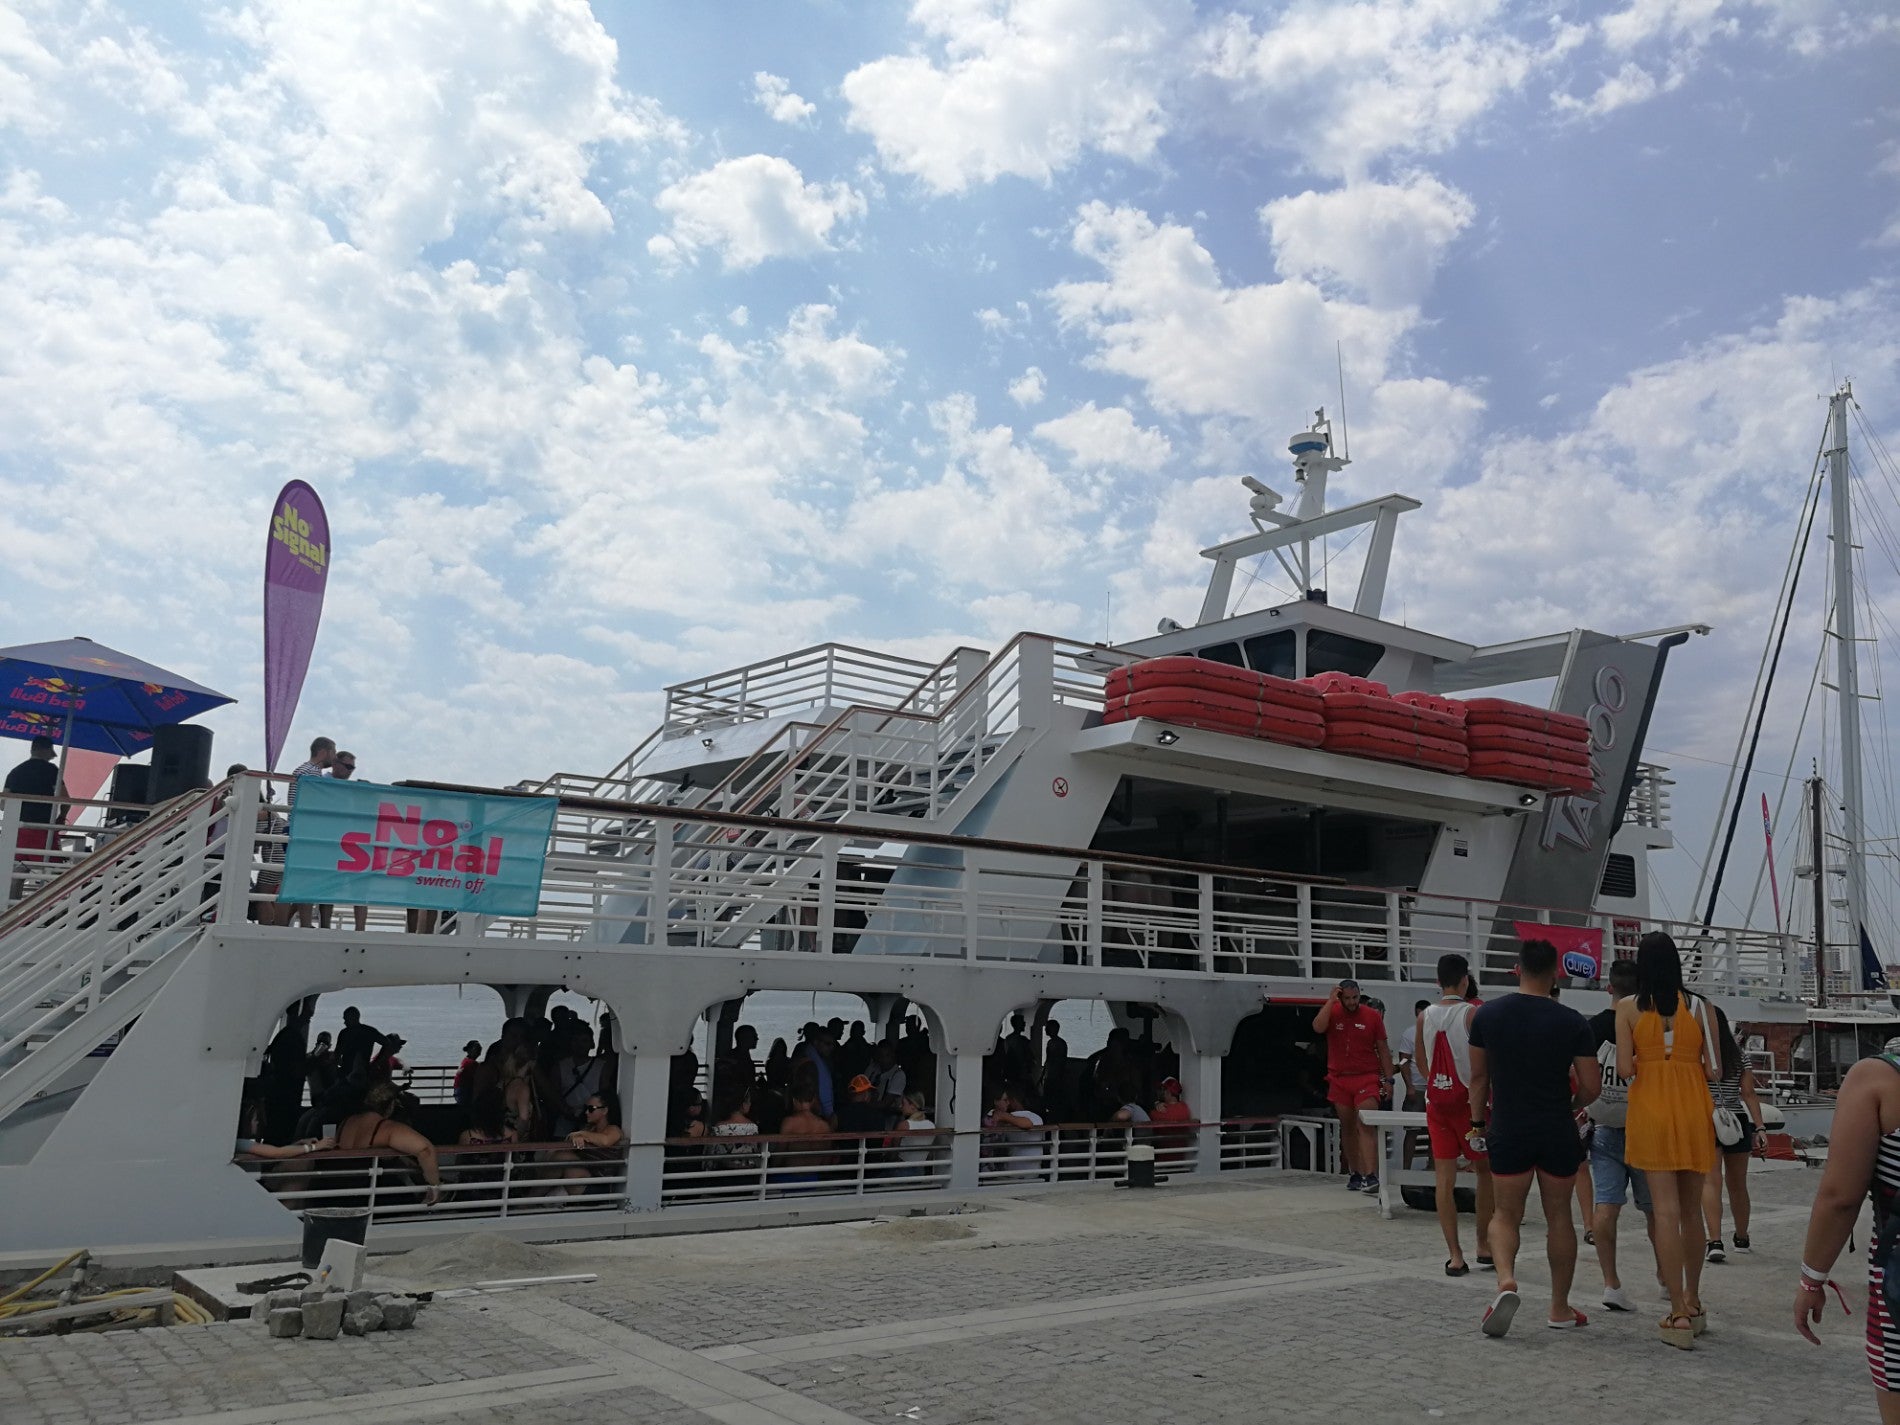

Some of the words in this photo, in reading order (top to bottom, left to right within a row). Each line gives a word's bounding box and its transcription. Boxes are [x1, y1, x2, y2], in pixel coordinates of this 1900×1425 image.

[273, 515, 326, 567] Signal
[284, 502, 310, 538] No
[1541, 665, 1626, 851] TAOO
[375, 802, 459, 847] No
[337, 832, 504, 877] Signal
[416, 874, 461, 889] switch
[1566, 957, 1594, 976] durex
